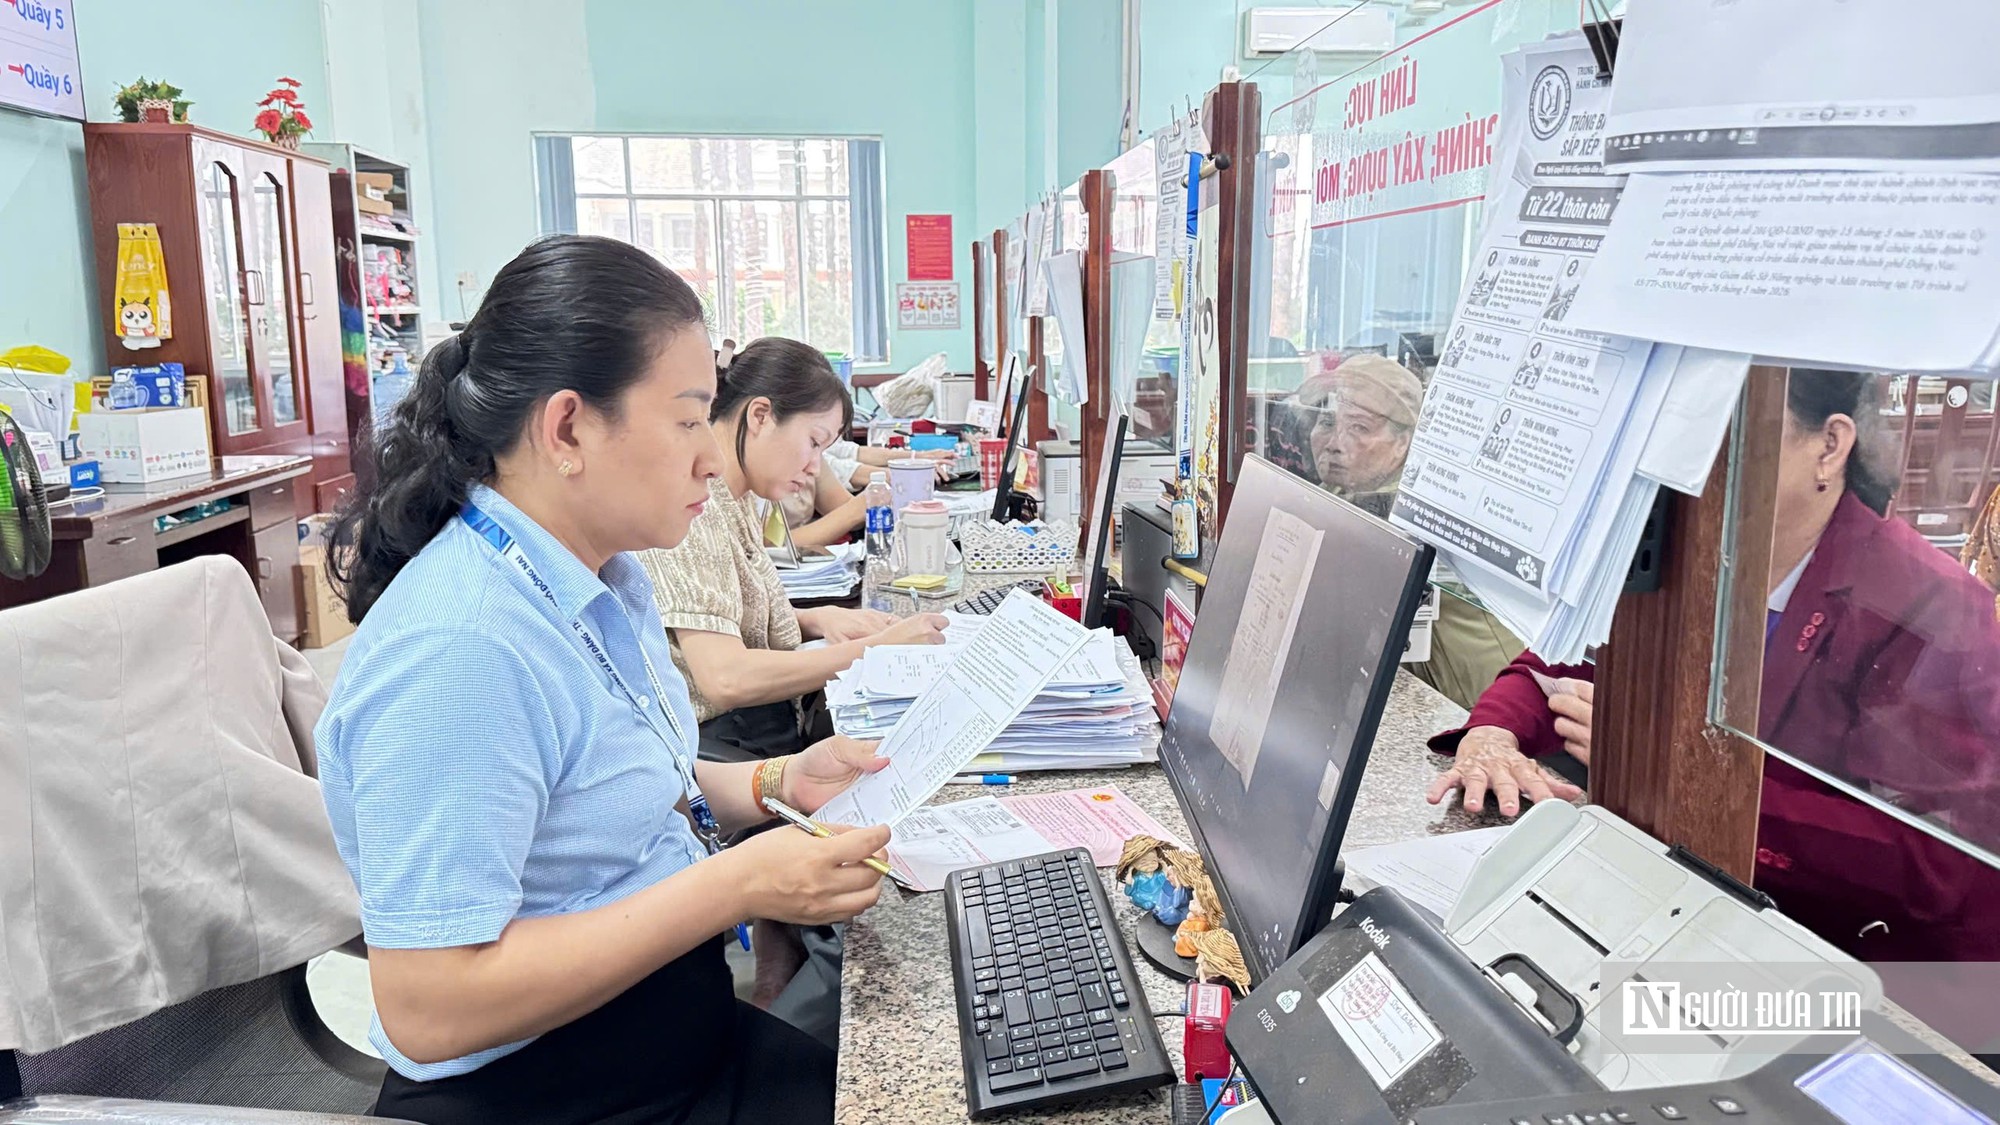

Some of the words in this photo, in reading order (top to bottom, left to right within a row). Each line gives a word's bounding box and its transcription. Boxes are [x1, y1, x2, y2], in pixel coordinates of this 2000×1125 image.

[16, 0, 51, 30] Quầy
[55, 8, 64, 30] 5
[24, 64, 59, 96] Quầy
[64, 74, 72, 94] 6
[1569, 111, 1594, 131] THÔNG
[1561, 133, 1579, 156] SẮP
[1578, 132, 1600, 156] XẾP
[1526, 195, 1544, 216] Từ
[1539, 190, 1565, 217] 22
[1560, 197, 1588, 219] thôn
[1586, 197, 1611, 220] còn
[515, 555, 529, 570] NAI
[527, 569, 546, 592] ĐỒNG
[580, 631, 600, 653] ĐĂNG
[1359, 916, 1390, 950] Kodak
[1256, 1008, 1277, 1032] E1035
